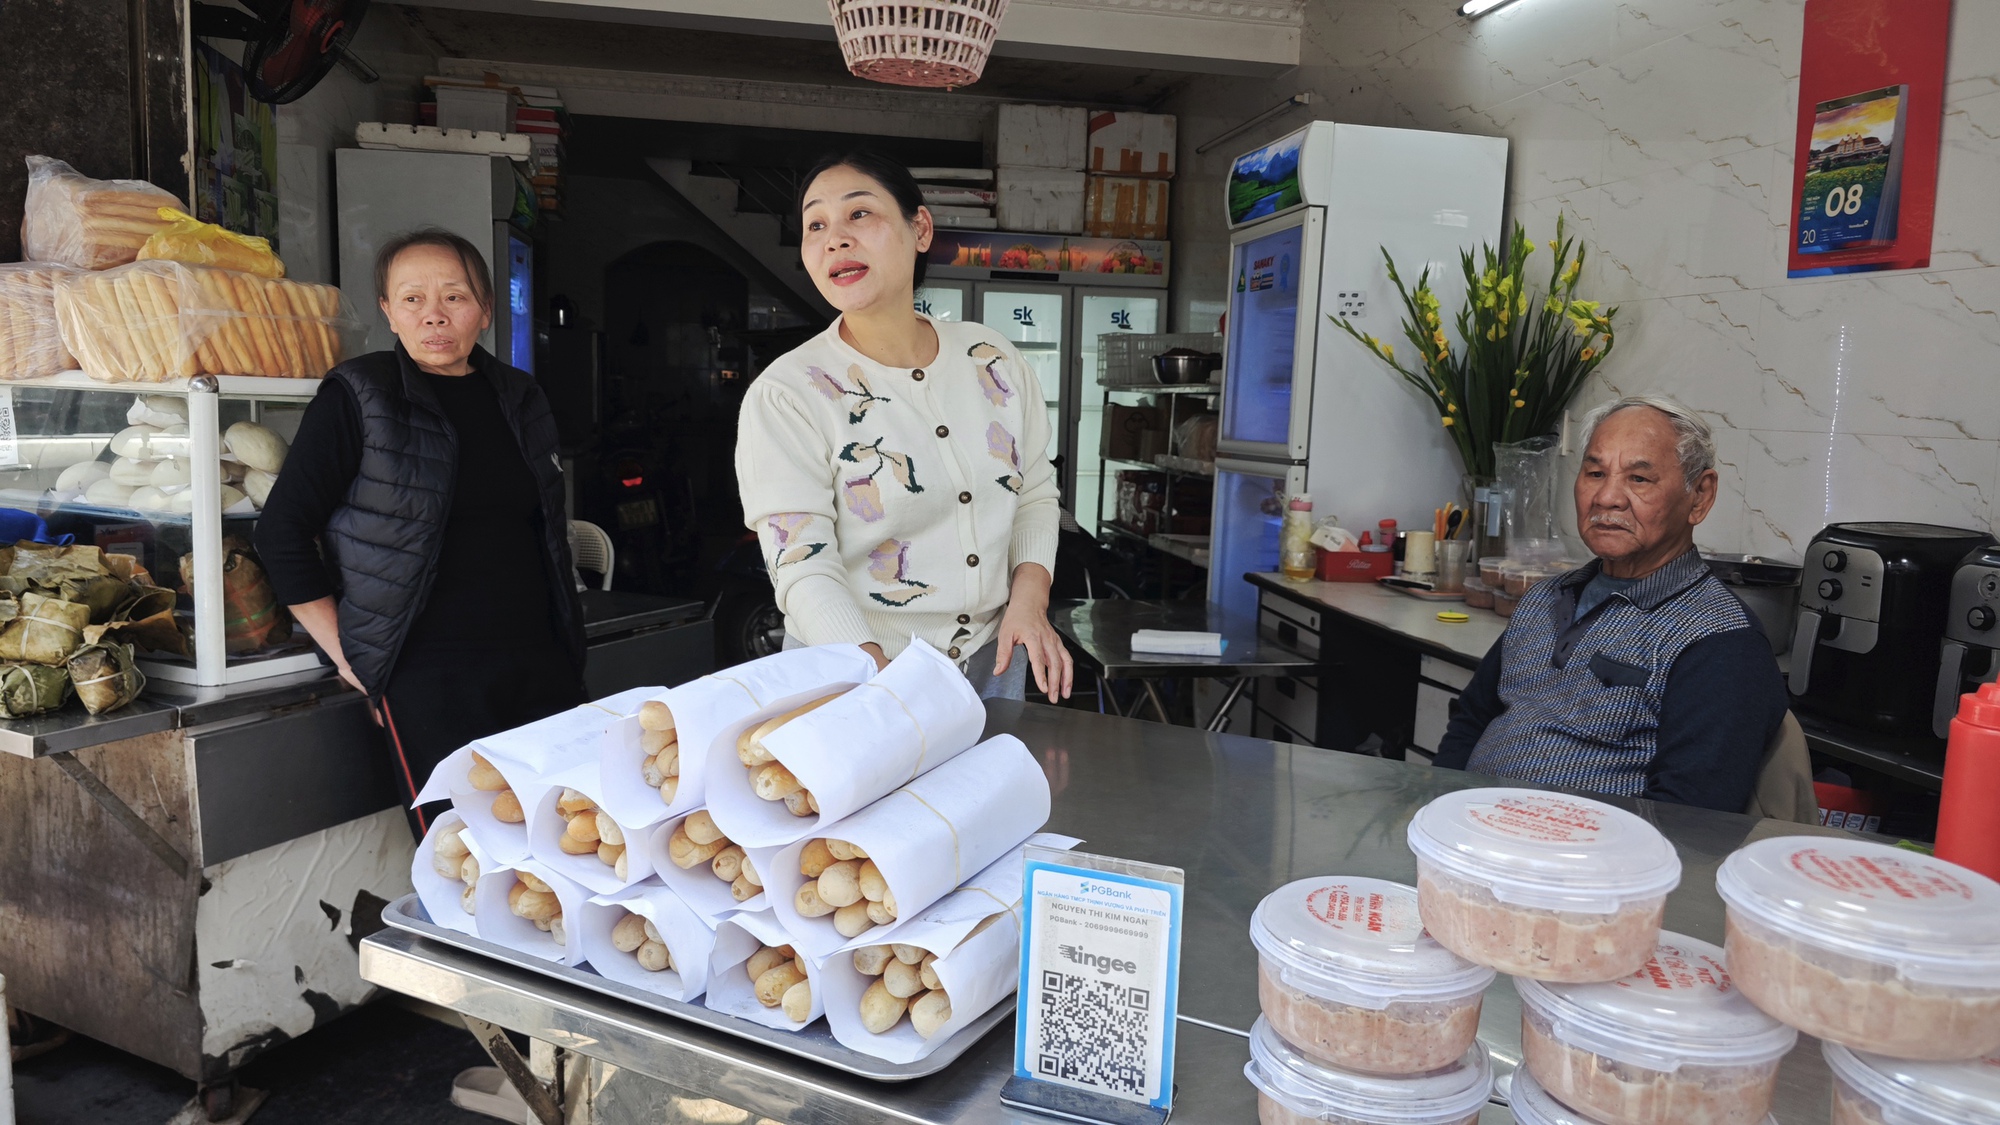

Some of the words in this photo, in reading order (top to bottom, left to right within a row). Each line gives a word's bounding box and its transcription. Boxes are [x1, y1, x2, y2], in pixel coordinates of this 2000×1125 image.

[1825, 183, 1863, 217] 08
[1802, 229, 1816, 245] 20
[1013, 306, 1033, 321] sk
[1110, 309, 1130, 325] sk
[1091, 884, 1132, 900] PGBank
[1049, 915, 1078, 926] PGBank
[1051, 902, 1087, 915] NGUYEN
[1089, 908, 1103, 918] THI
[1105, 912, 1121, 921] KIM
[1123, 915, 1148, 926] NGAN
[1367, 910, 1386, 933] NGÂN
[1059, 944, 1137, 975] tingee
